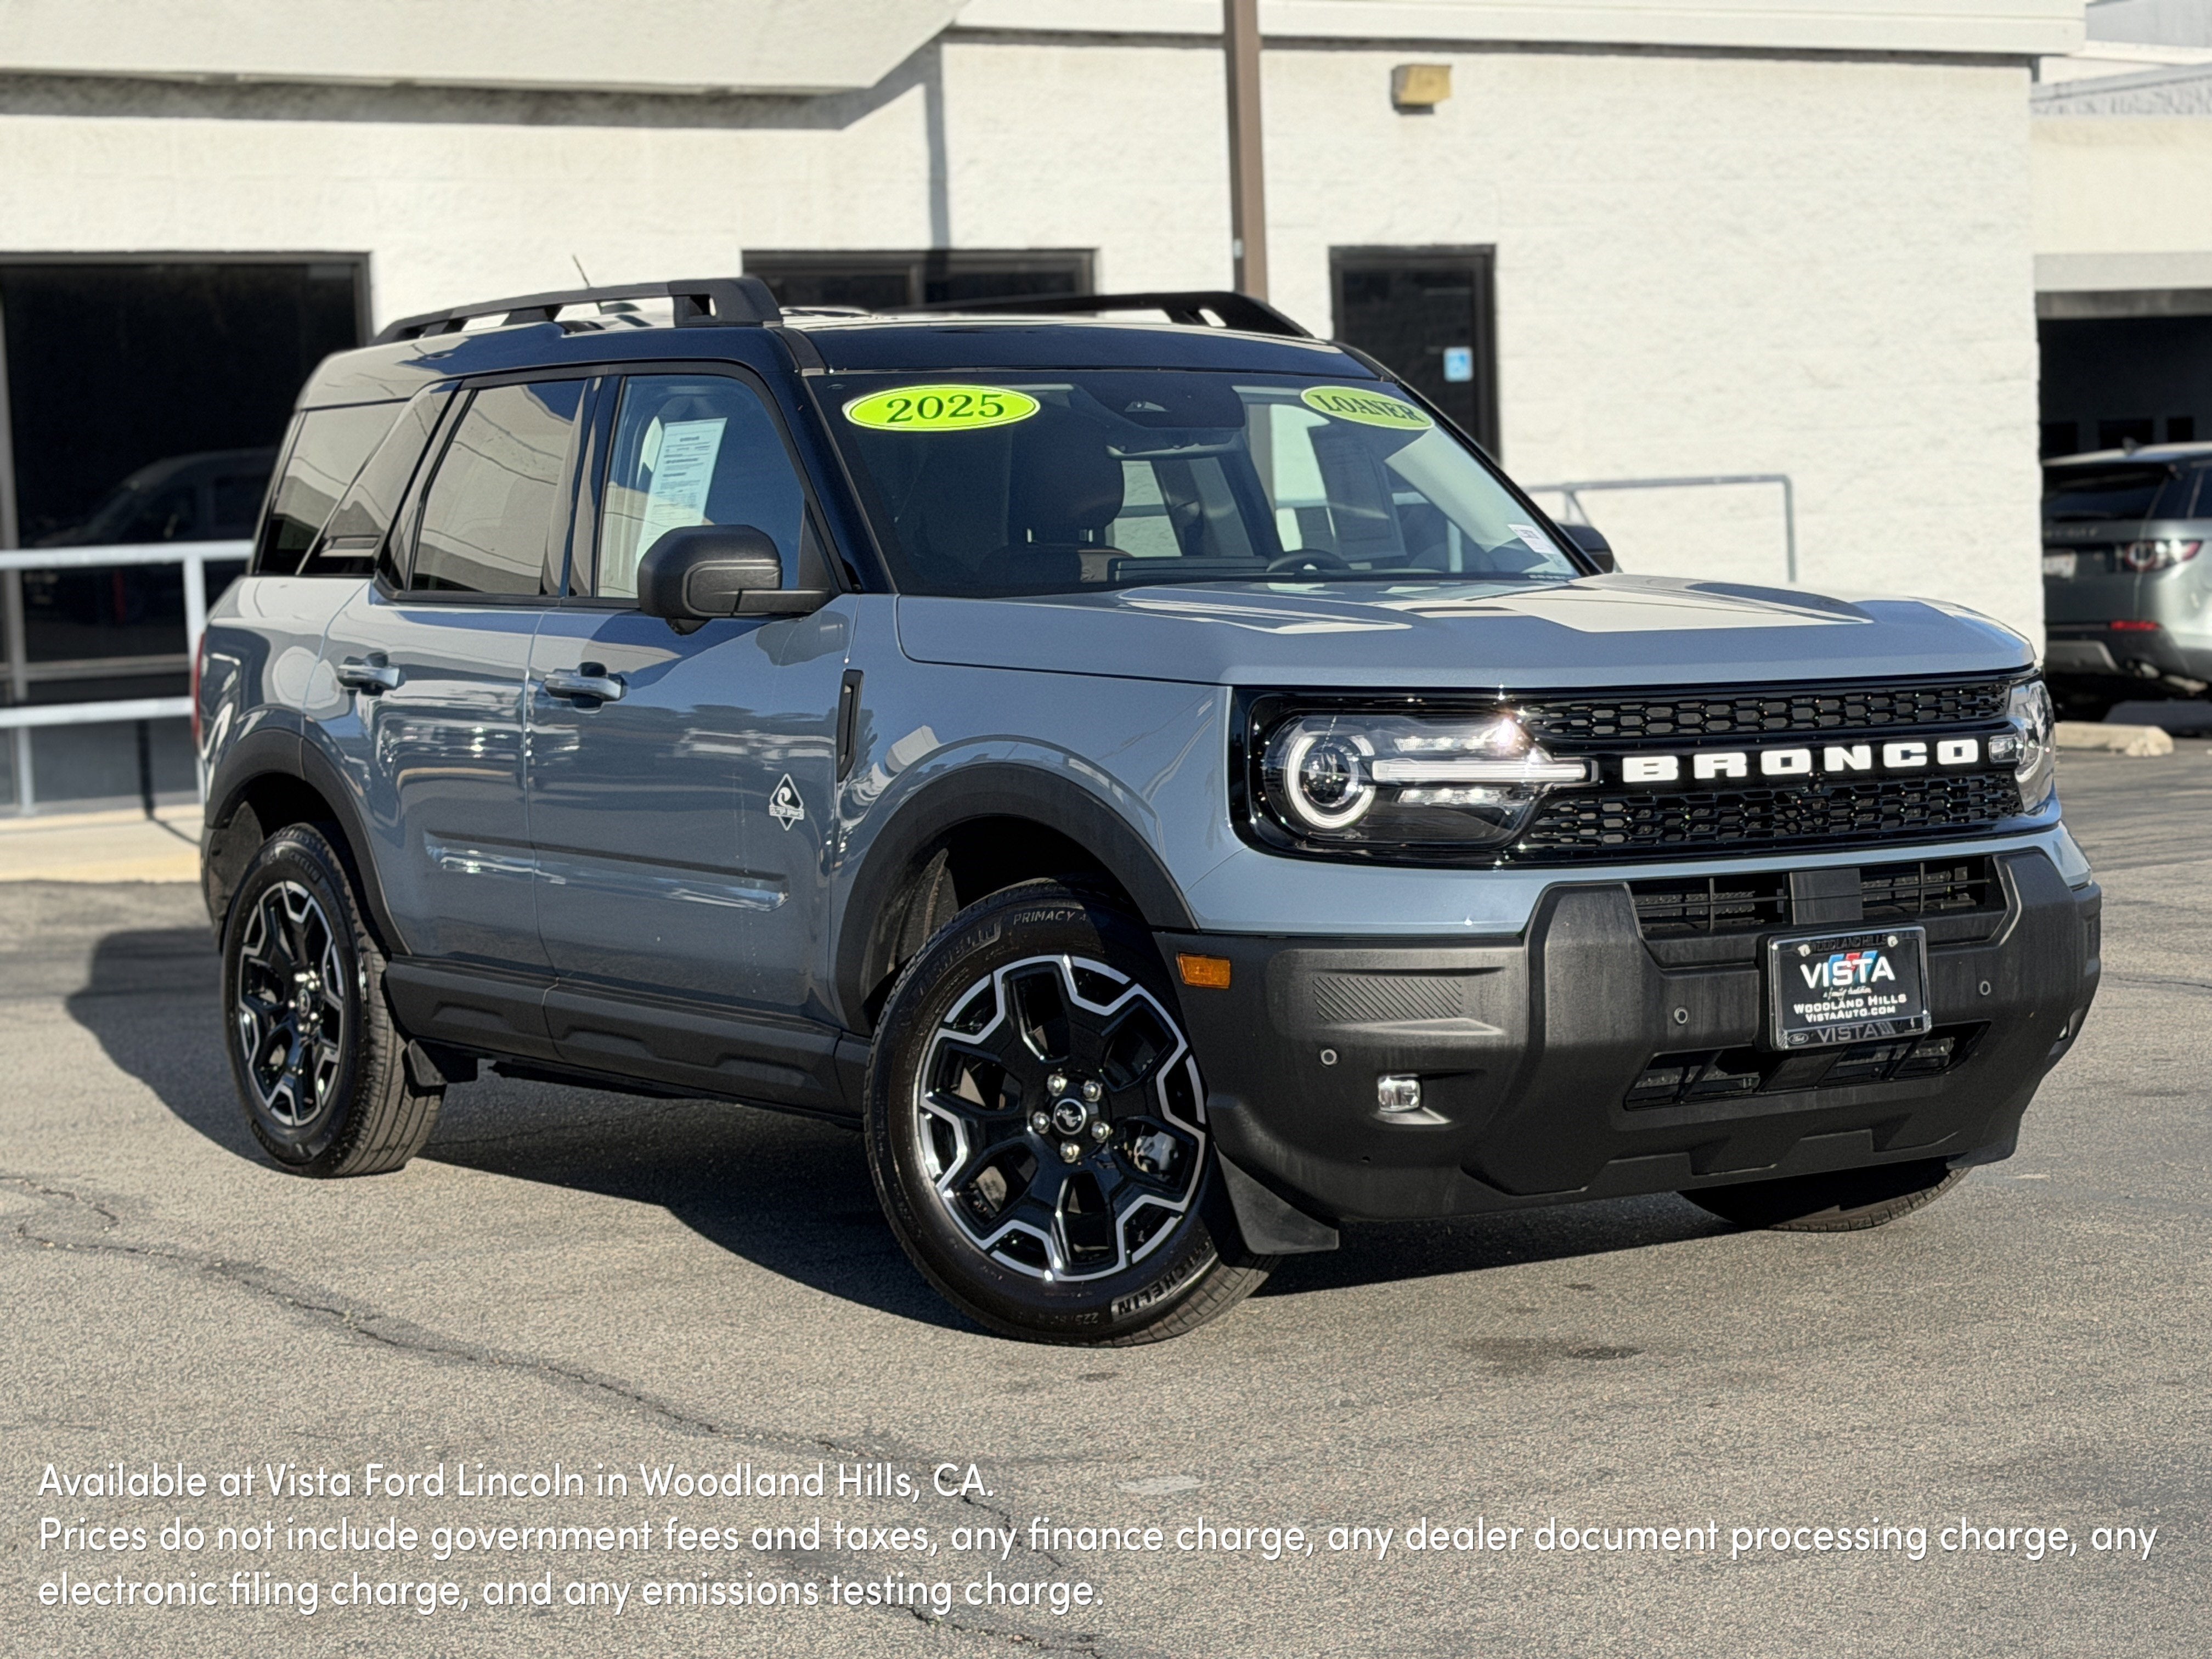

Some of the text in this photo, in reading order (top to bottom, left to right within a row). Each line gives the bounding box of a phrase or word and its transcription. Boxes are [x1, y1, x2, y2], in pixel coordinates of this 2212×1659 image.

[886, 394, 1005, 423] 2025
[1313, 394, 1421, 422] LOANER
[1622, 738, 1979, 783] BRONCO
[1013, 910, 1076, 926] PRIMACY
[1800, 956, 1895, 989] VISTA
[1793, 994, 1906, 1014] WOODLAND HILLS
[1818, 1023, 1878, 1043] VISTA
